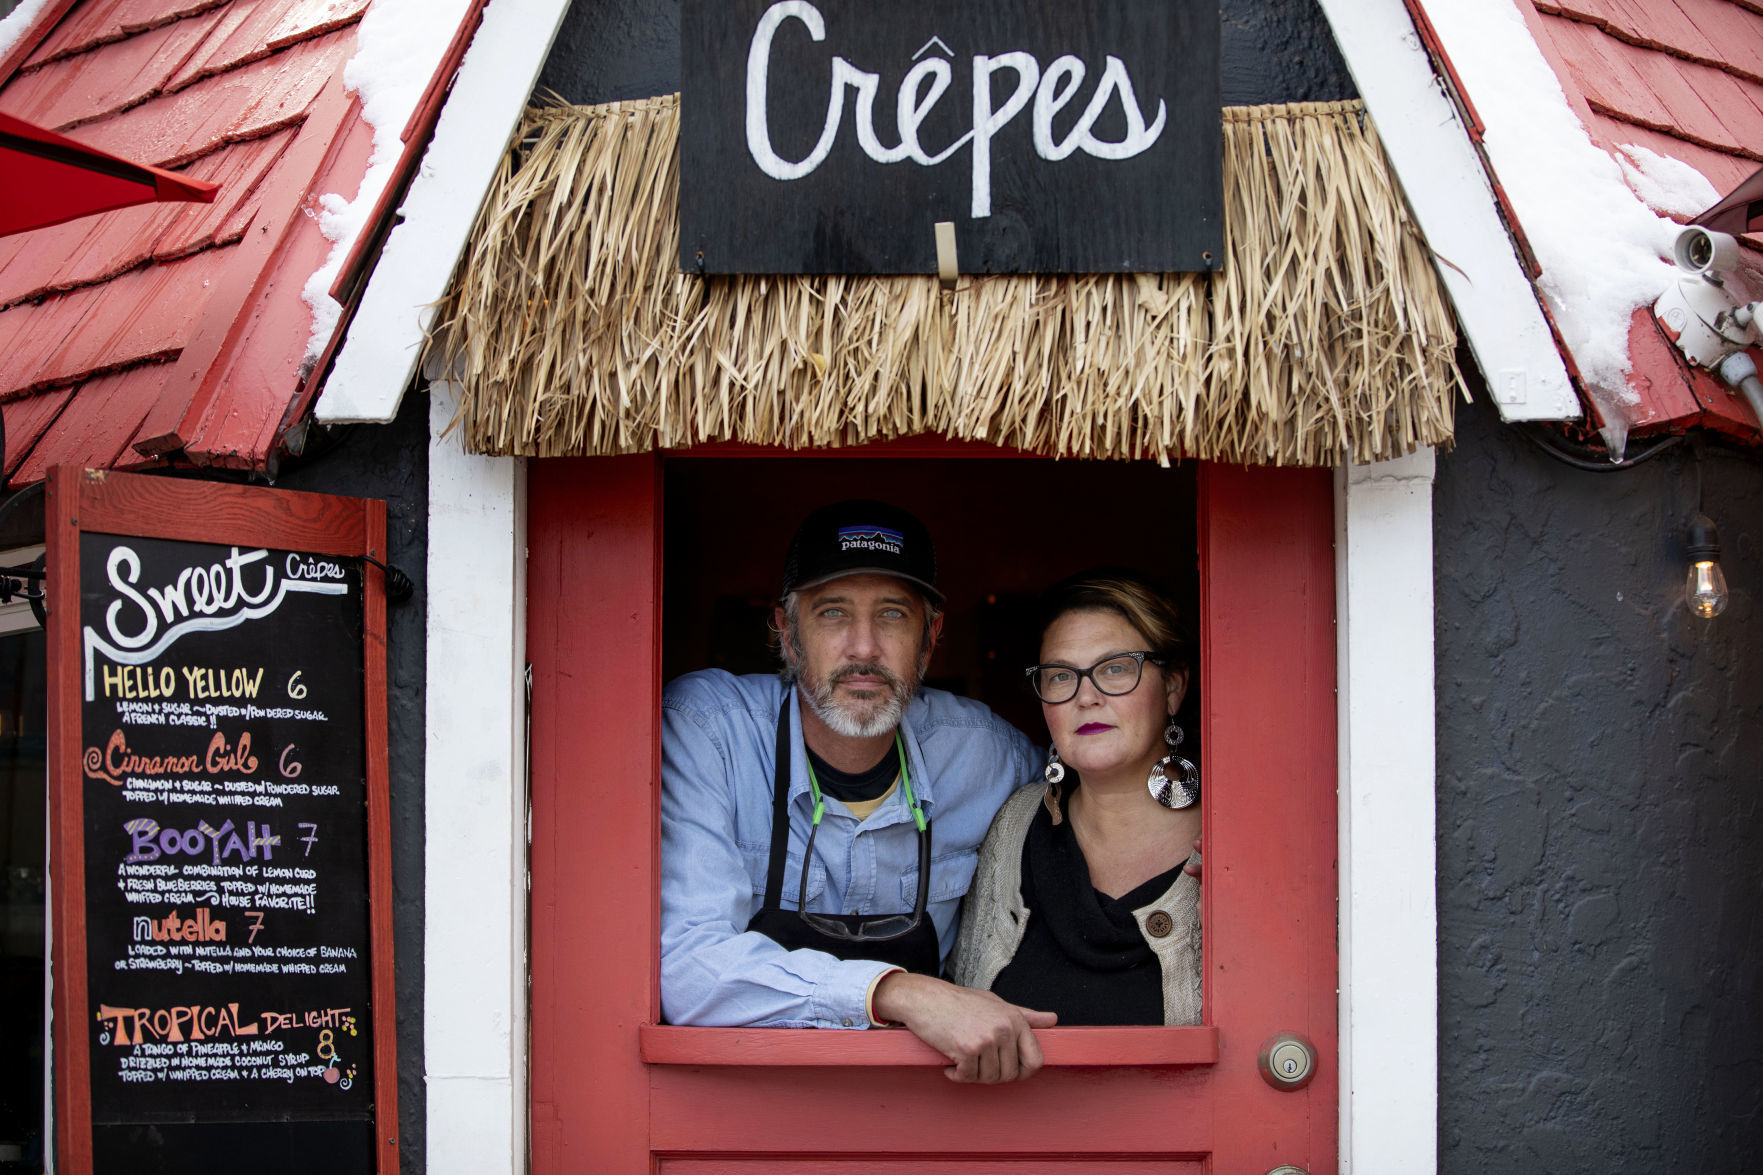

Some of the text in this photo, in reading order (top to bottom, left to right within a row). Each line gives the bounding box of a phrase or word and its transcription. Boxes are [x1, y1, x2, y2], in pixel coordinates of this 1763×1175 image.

[746, 0, 1166, 218] Crêpes
[841, 539, 900, 554] patagonia
[106, 546, 345, 648] Sweet Crêpes
[103, 665, 307, 699] HELLO YELLOW 6
[117, 701, 152, 713] LEMON
[162, 702, 192, 714] SUGAR
[205, 704, 239, 717] DUSTED
[294, 710, 328, 720] SUGAR
[123, 712, 130, 724] A
[131, 712, 165, 725] FRENCH
[105, 729, 302, 778] Cinnamon Girl 6
[126, 777, 173, 791] CINNAMON
[182, 780, 212, 791] SUGAR
[224, 781, 254, 793] DUSTED
[266, 782, 310, 794] POWDERED
[312, 785, 340, 796] SUGAR
[122, 791, 156, 802] TOPPED
[169, 792, 216, 805] HOMEMADE
[217, 795, 253, 806] WHIPPED
[254, 796, 283, 807] CREAM
[298, 822, 318, 857] 7
[118, 863, 317, 879] A WONDERFUL COMBINATION OF LEMON CURD
[127, 878, 154, 890] FRESH
[220, 881, 255, 893] TOPPED
[269, 883, 317, 895] HOMEMADE
[125, 892, 162, 903] WHIPPED
[164, 892, 195, 904] CREAM
[221, 892, 252, 908] HOUSE
[133, 907, 264, 944] nutella 7
[128, 944, 357, 958] LOADED WITH NUTELLA AND YOUR CHOICE OF BANANA
[115, 960, 127, 970] OR
[128, 957, 183, 975] STRAWBERRY
[191, 959, 223, 973] TOPPED
[234, 961, 279, 973] HOMEMADE
[281, 962, 317, 974] WHIPPED
[319, 963, 346, 974] CREAM
[100, 1003, 351, 1046] TROPICAL DELIGHT
[133, 1044, 141, 1056] A
[142, 1043, 174, 1056] TANGO
[176, 1043, 188, 1055] OF
[190, 1041, 240, 1056] PINEAPPLE
[250, 1040, 284, 1053] MANGO
[317, 1029, 335, 1059] 8
[120, 1053, 310, 1069] DRIZZLED IN HOMEMADE COCONUT SYRUP
[118, 1070, 155, 1083] TOPPED
[168, 1070, 209, 1082] WHIPPED
[210, 1069, 240, 1081] CREAM
[250, 1069, 258, 1079] A
[261, 1066, 294, 1084] CHERRY
[295, 1067, 308, 1077] ON
[308, 1065, 327, 1078] TOP
